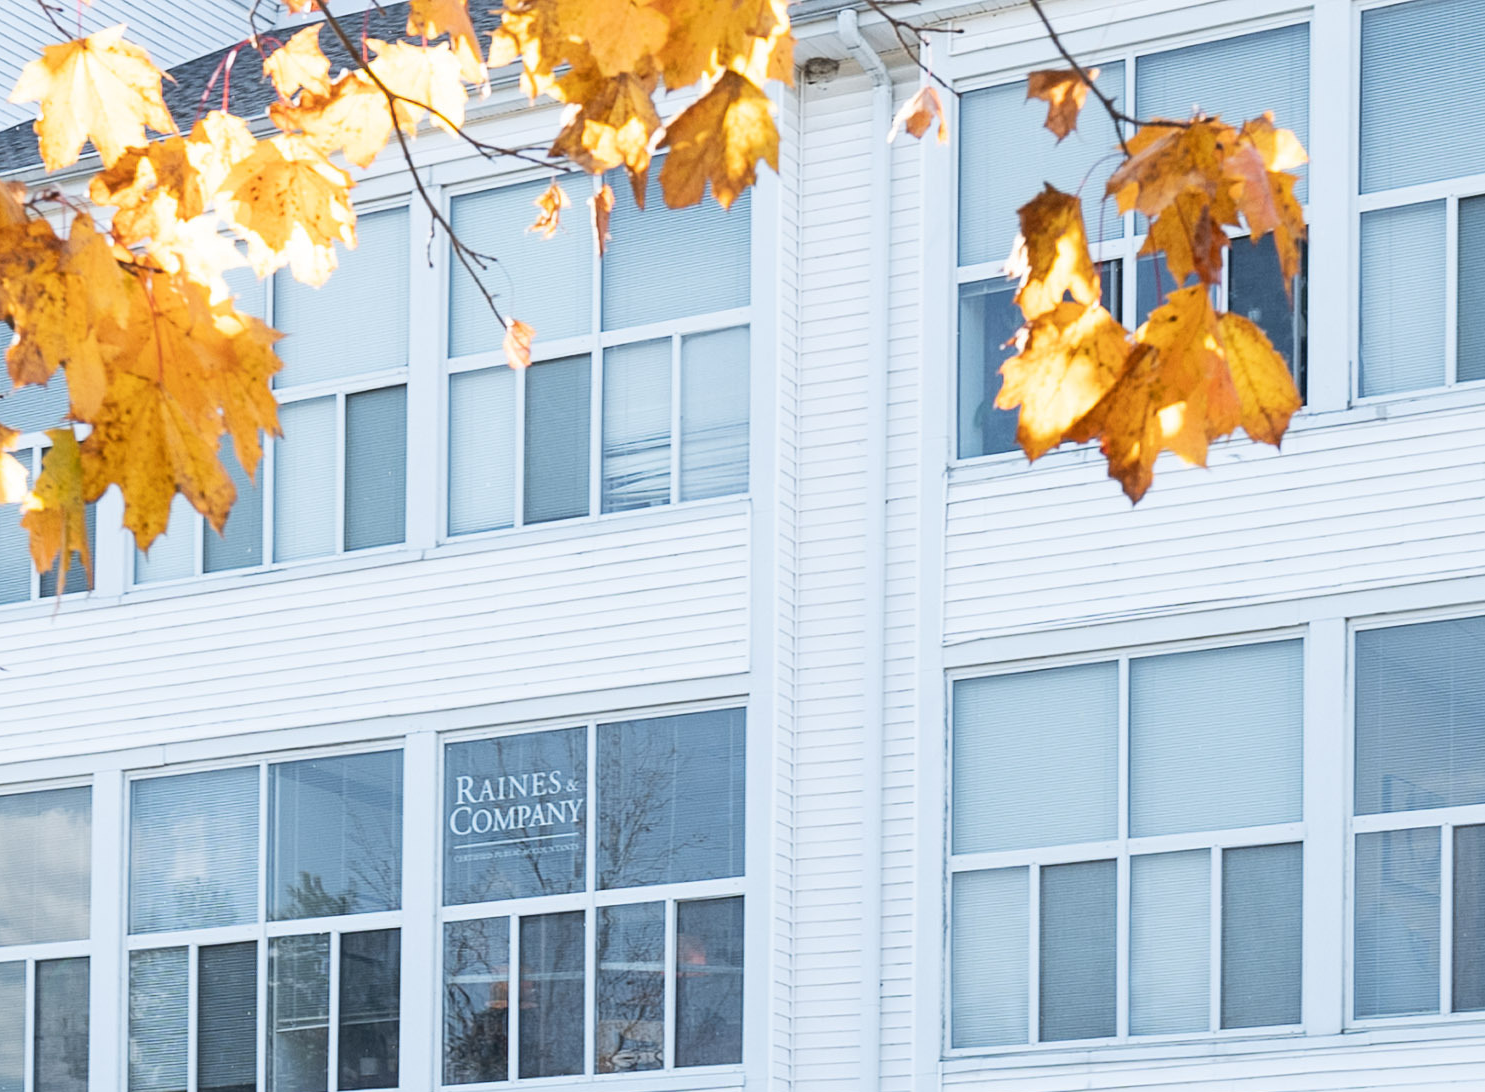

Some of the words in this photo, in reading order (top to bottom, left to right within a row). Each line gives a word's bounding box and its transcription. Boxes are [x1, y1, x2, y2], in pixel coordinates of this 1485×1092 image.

[455, 770, 561, 805] RAINES
[566, 779, 579, 792] &
[450, 799, 584, 836] COMPANY
